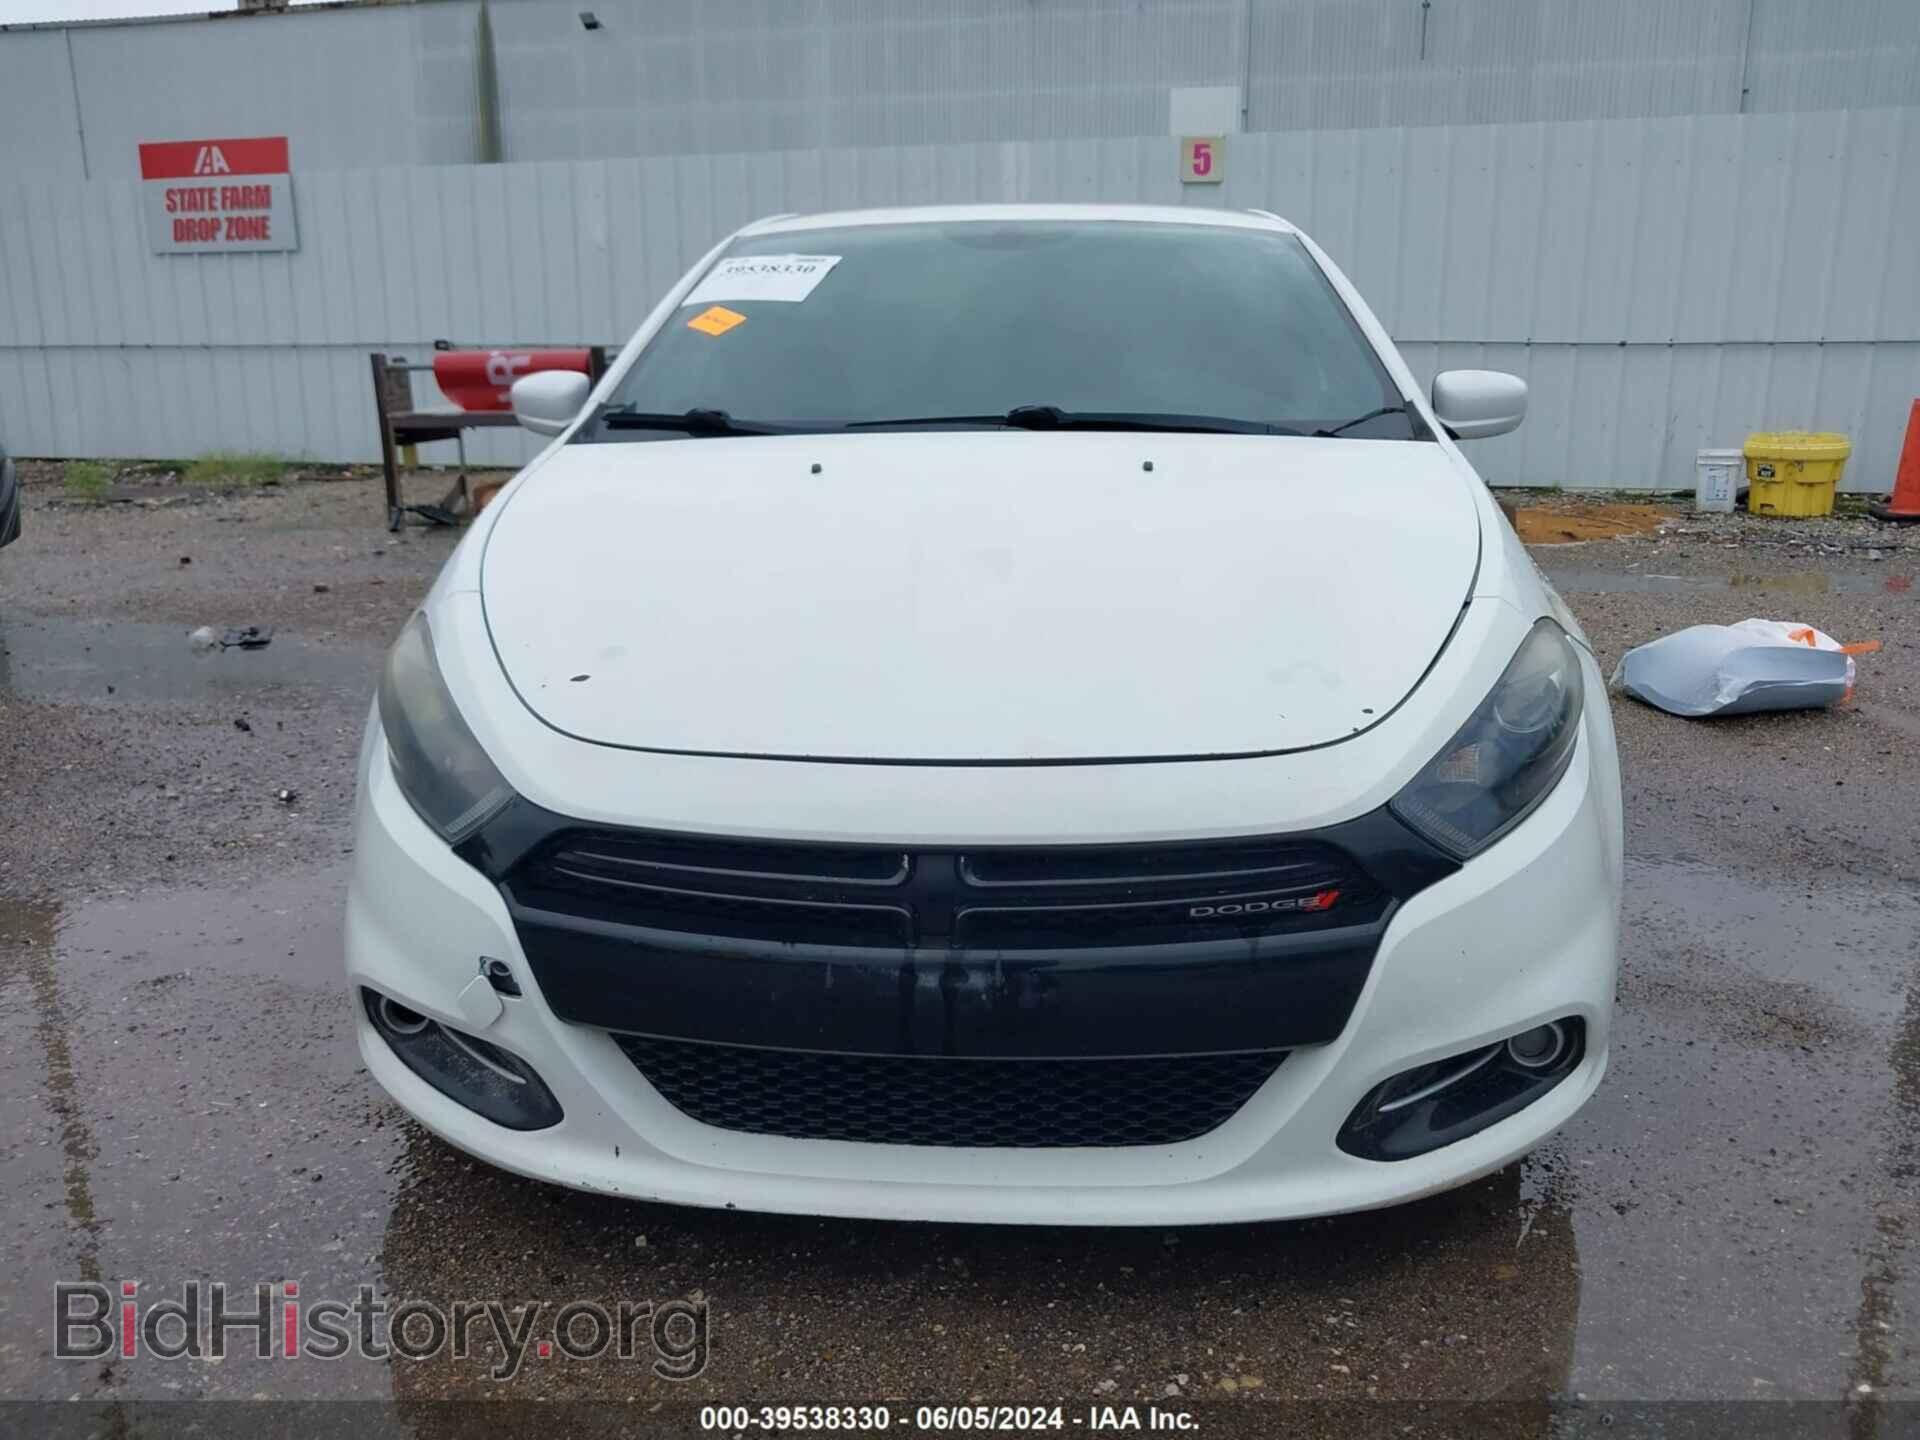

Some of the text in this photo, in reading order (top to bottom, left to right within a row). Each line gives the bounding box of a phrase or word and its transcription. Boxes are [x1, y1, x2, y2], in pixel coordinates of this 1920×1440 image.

[1193, 143, 1211, 176] 5
[165, 185, 272, 212] STATE FARM
[173, 216, 271, 241] DROP ZONE
[1189, 896, 1322, 917] DODGE
